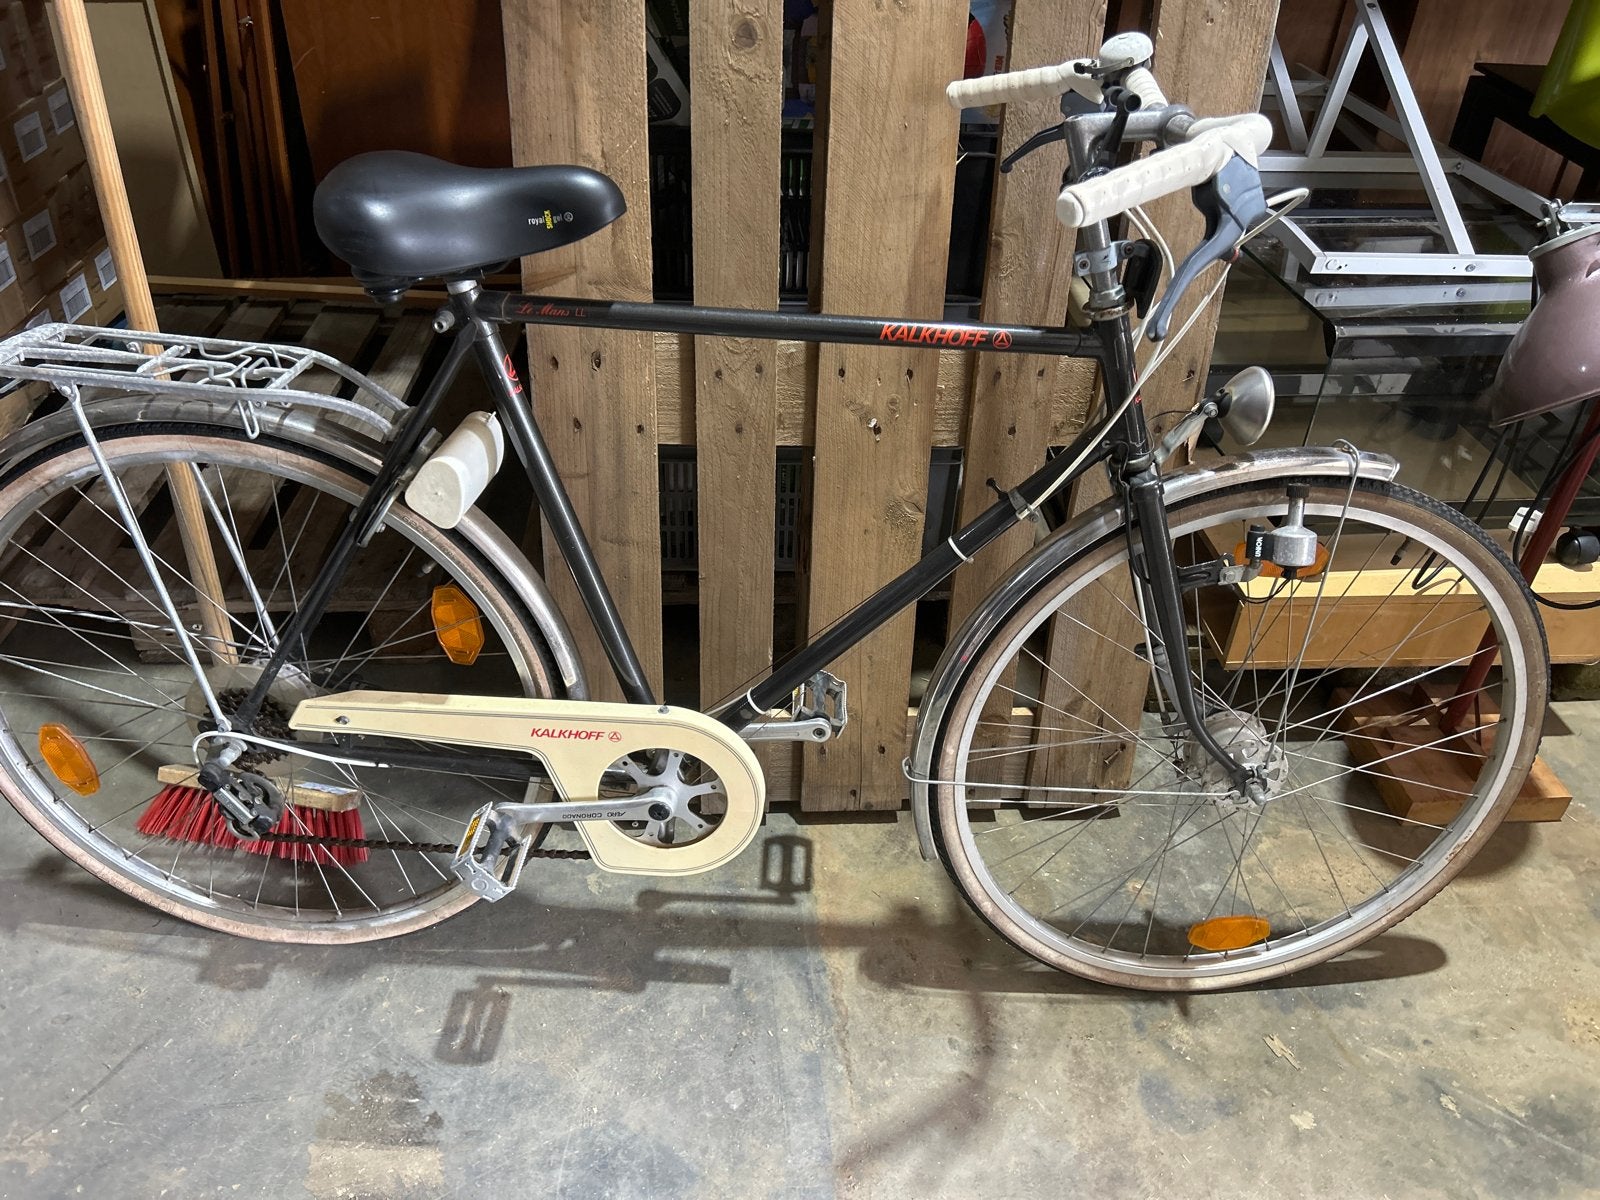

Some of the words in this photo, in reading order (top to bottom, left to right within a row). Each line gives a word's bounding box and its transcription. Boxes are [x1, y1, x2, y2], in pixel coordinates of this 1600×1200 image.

[528, 214, 545, 226] royal
[516, 303, 534, 315] Le
[535, 303, 570, 317] Mans
[880, 323, 989, 347] KALKHOFF
[1254, 536, 1264, 558] UNION
[530, 727, 606, 741] KALKHOFF
